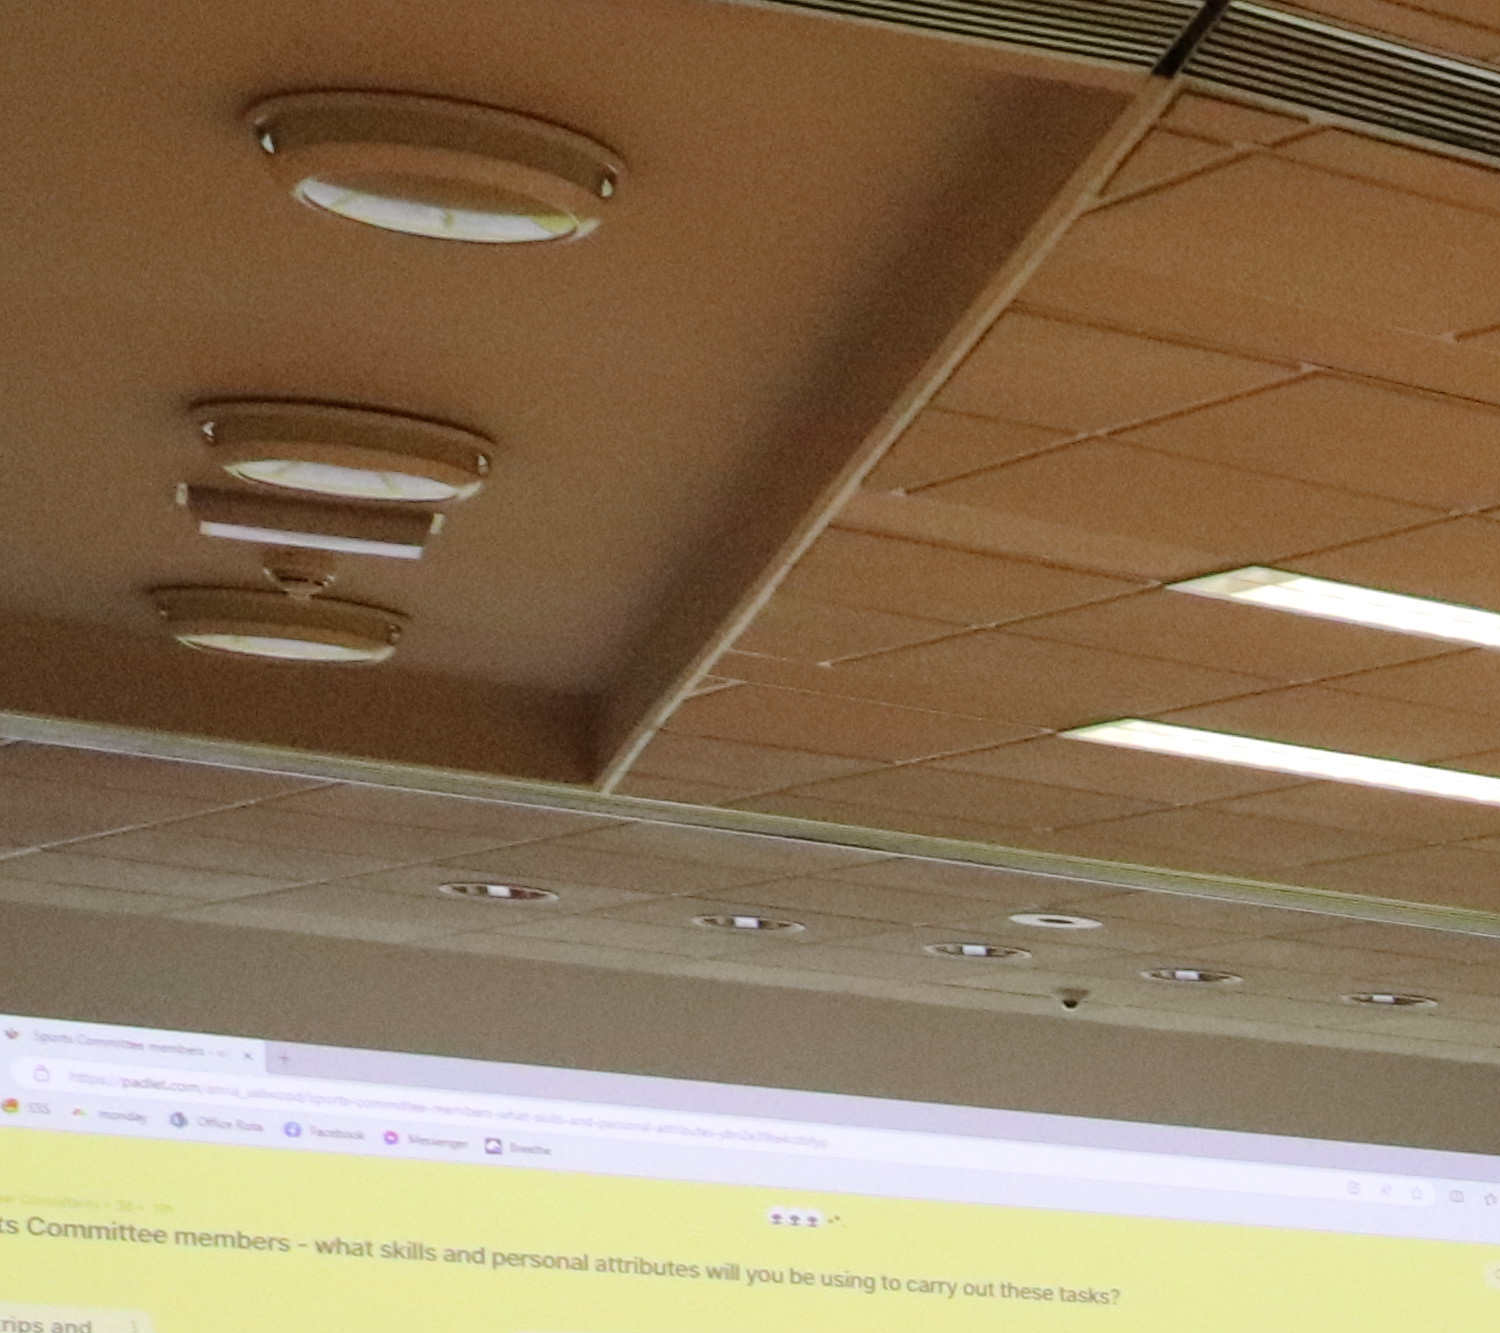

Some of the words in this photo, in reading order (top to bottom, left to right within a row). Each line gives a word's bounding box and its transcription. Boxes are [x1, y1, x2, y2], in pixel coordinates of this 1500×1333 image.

[309, 1125, 366, 1142] Facebook
[408, 1134, 469, 1151] Messenger
[27, 1216, 168, 1244] Committee
[175, 1228, 291, 1253] members
[314, 1237, 374, 1258] what
[380, 1240, 437, 1262] skills
[443, 1246, 486, 1266] and
[491, 1253, 590, 1273] personal
[595, 1255, 700, 1280] attributes
[706, 1262, 741, 1282] will
[746, 1268, 785, 1288] you
[789, 1267, 816, 1287] be
[820, 1271, 877, 1295] using
[881, 1275, 902, 1293] to
[906, 1278, 958, 1300] carry
[963, 1281, 995, 1299] out
[1000, 1281, 1054, 1302] these
[1059, 1285, 1122, 1307] tasks?
